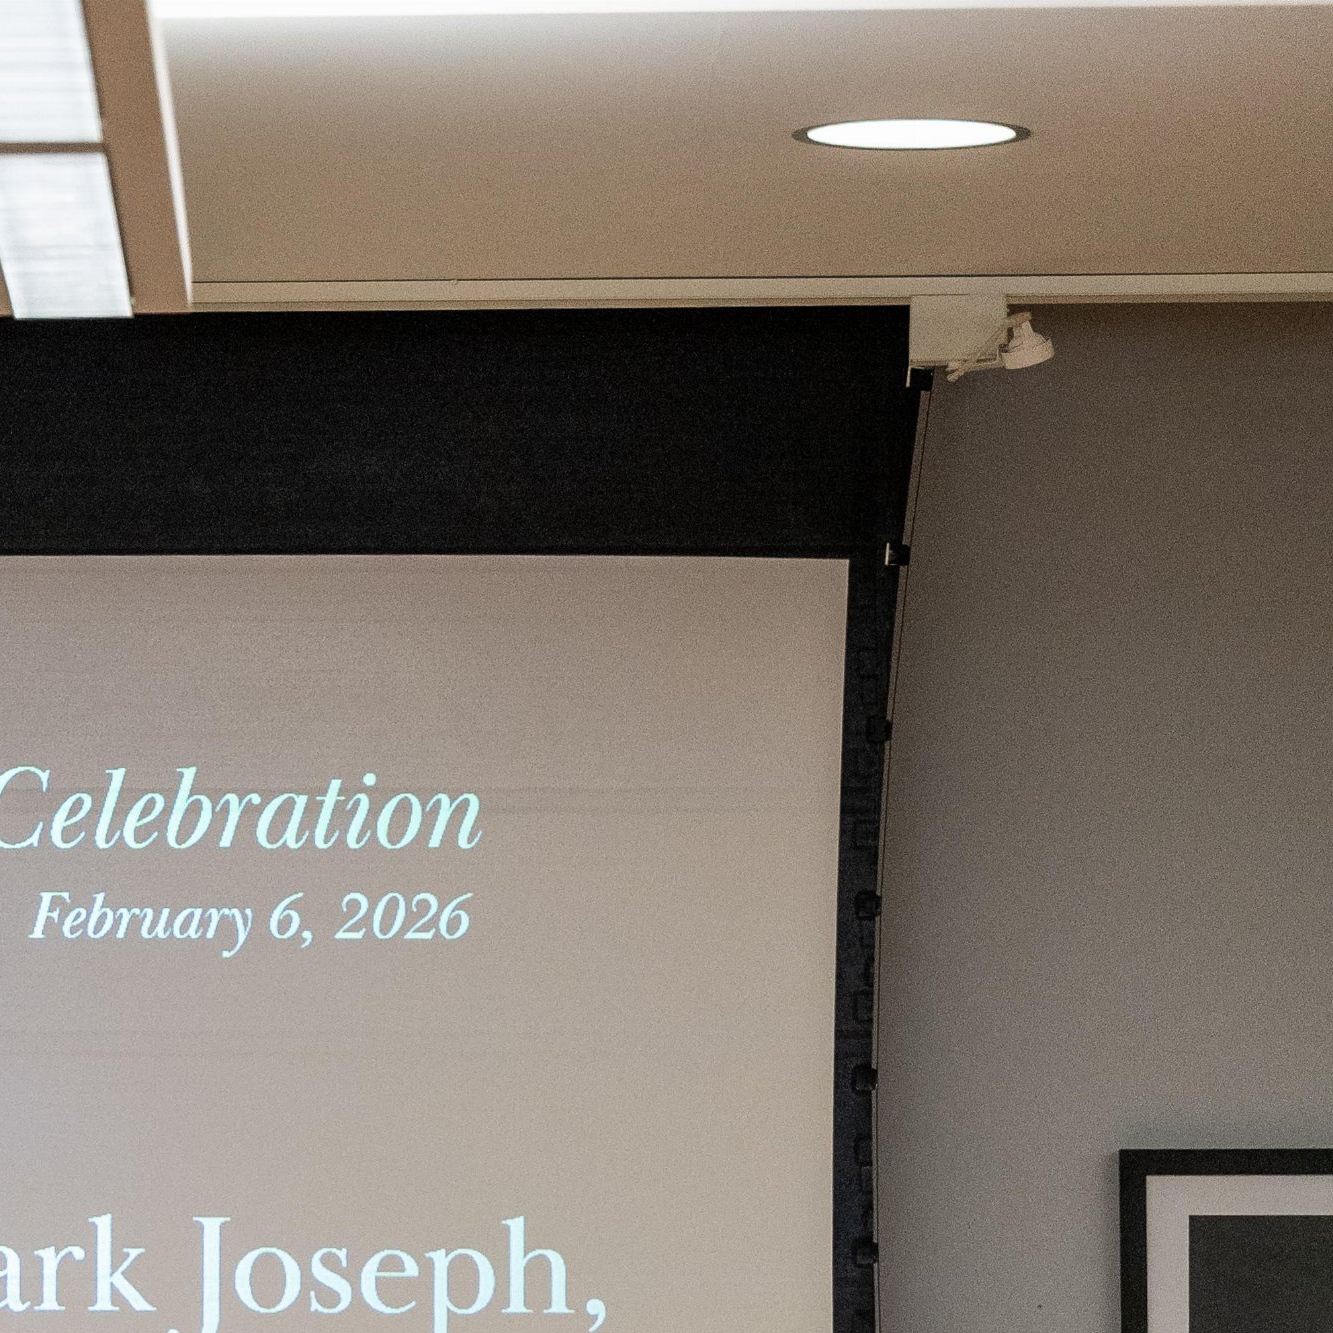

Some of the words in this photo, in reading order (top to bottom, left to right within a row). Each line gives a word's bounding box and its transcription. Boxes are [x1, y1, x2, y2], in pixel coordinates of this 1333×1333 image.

[28, 891, 253, 959] February
[268, 891, 313, 948] 6,
[334, 891, 473, 941] 2026
